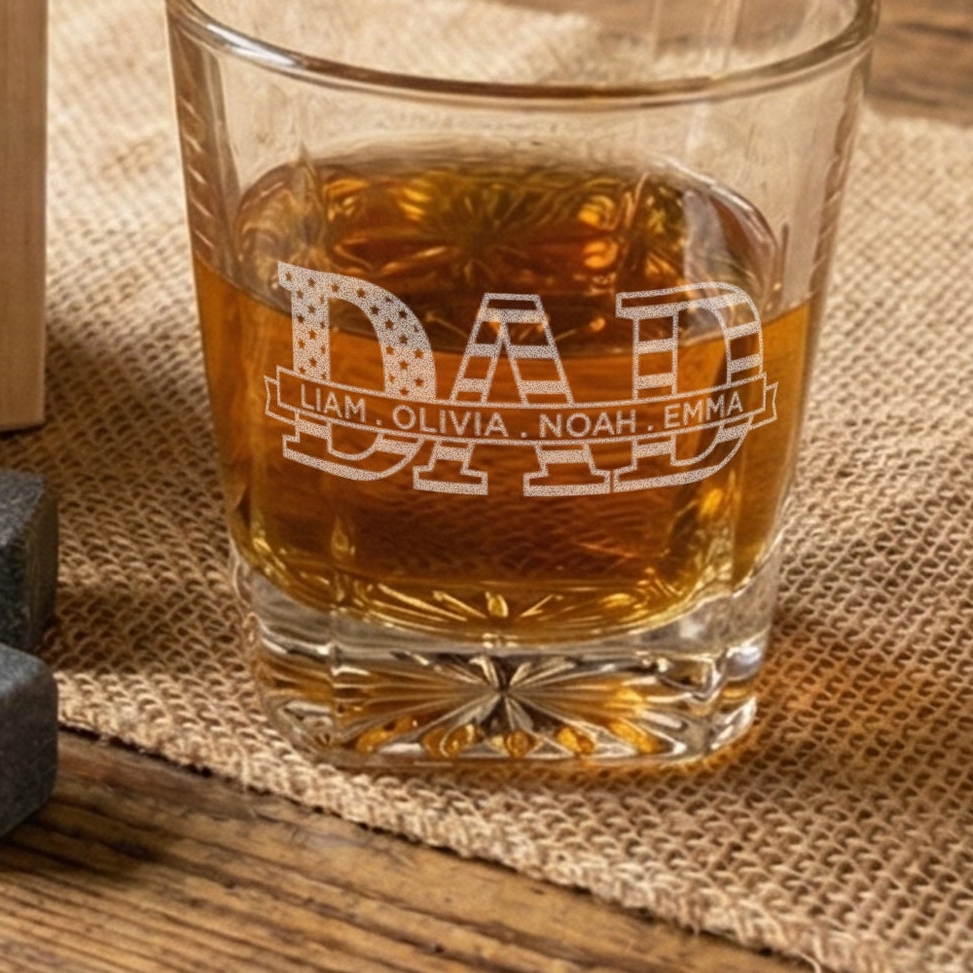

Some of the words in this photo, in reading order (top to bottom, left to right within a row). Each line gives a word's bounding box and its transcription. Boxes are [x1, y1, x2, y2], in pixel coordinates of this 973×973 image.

[277, 260, 764, 497] DAD
[300, 383, 367, 423] LIAM
[392, 404, 510, 438] OLIVIA
[538, 409, 637, 438] NOAH
[664, 391, 744, 428] EMMA
